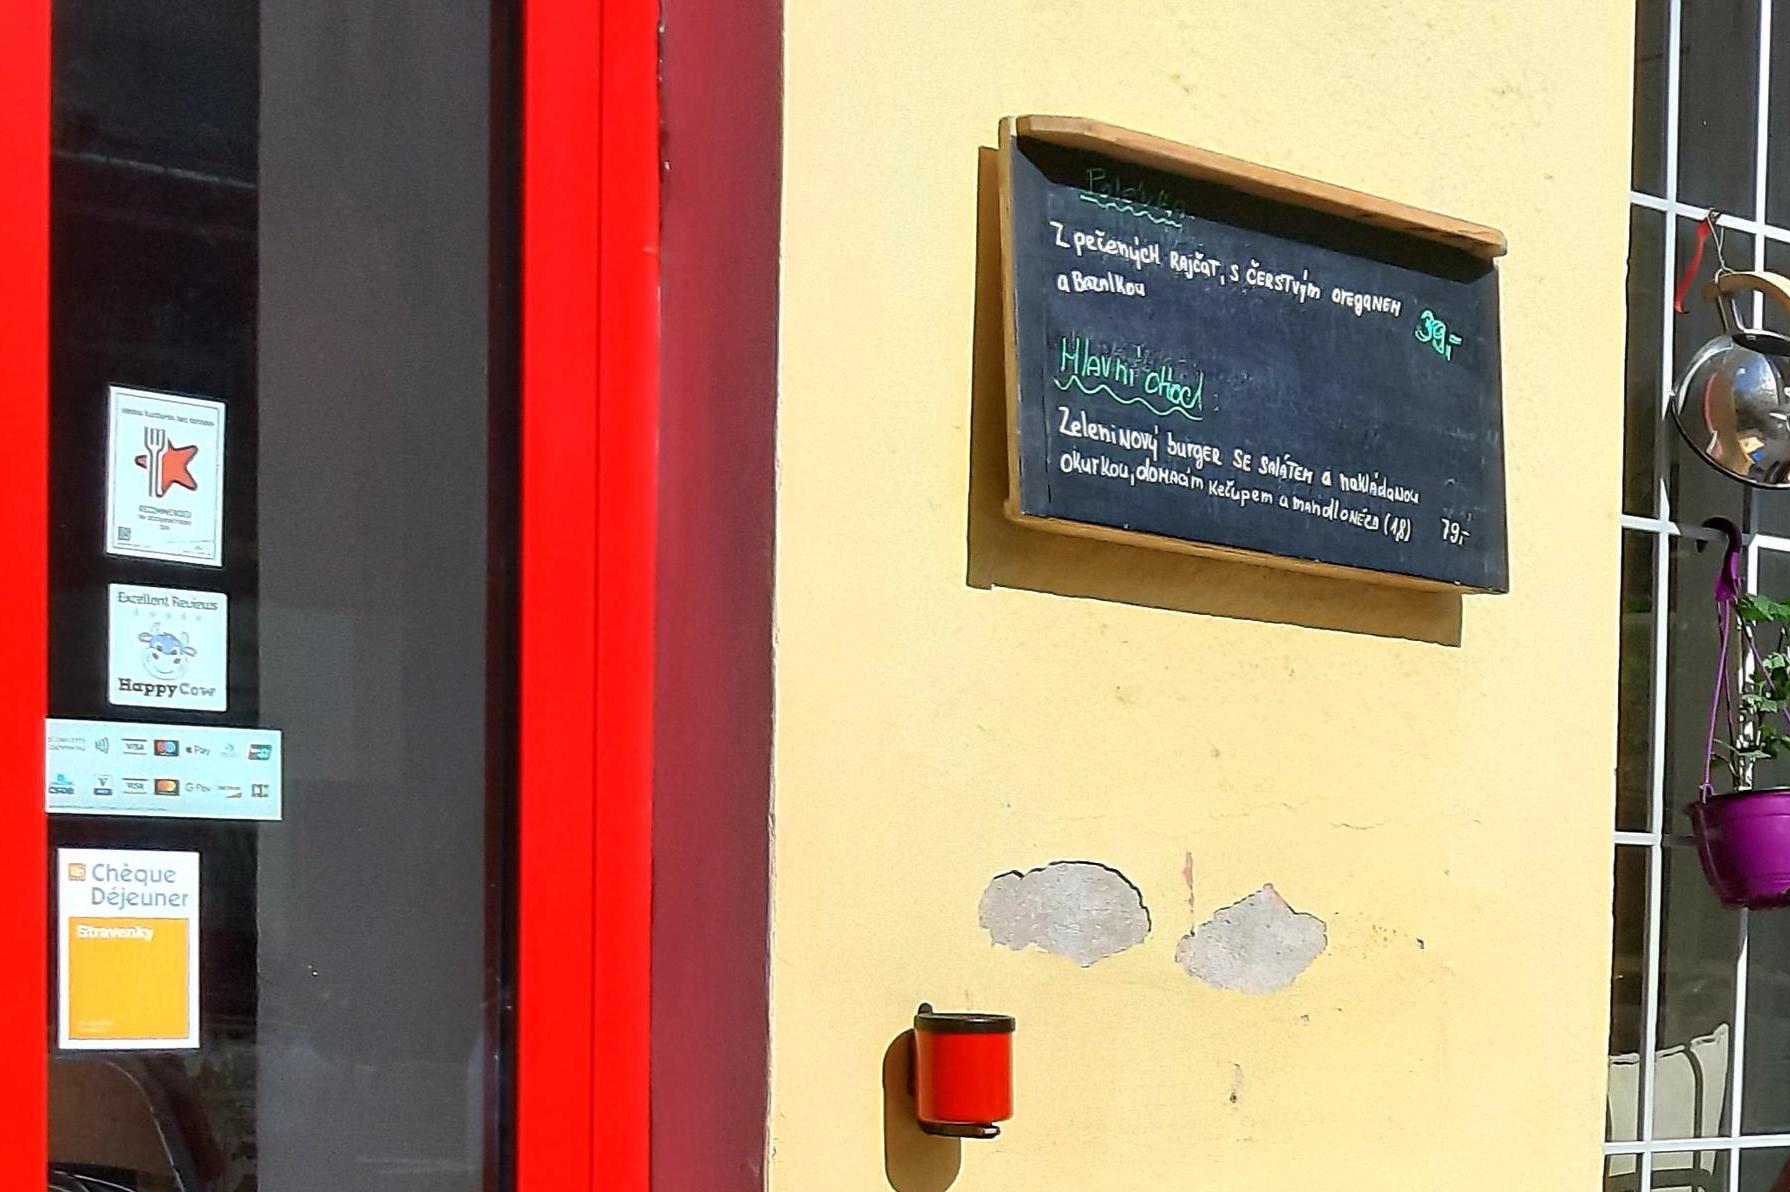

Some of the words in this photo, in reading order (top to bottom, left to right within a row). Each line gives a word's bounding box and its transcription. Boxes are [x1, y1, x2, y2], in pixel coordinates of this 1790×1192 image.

[118, 592, 170, 607] Excellent
[171, 596, 218, 610] Reviews
[91, 863, 176, 887] Chèque
[91, 886, 189, 910] Déjeuner
